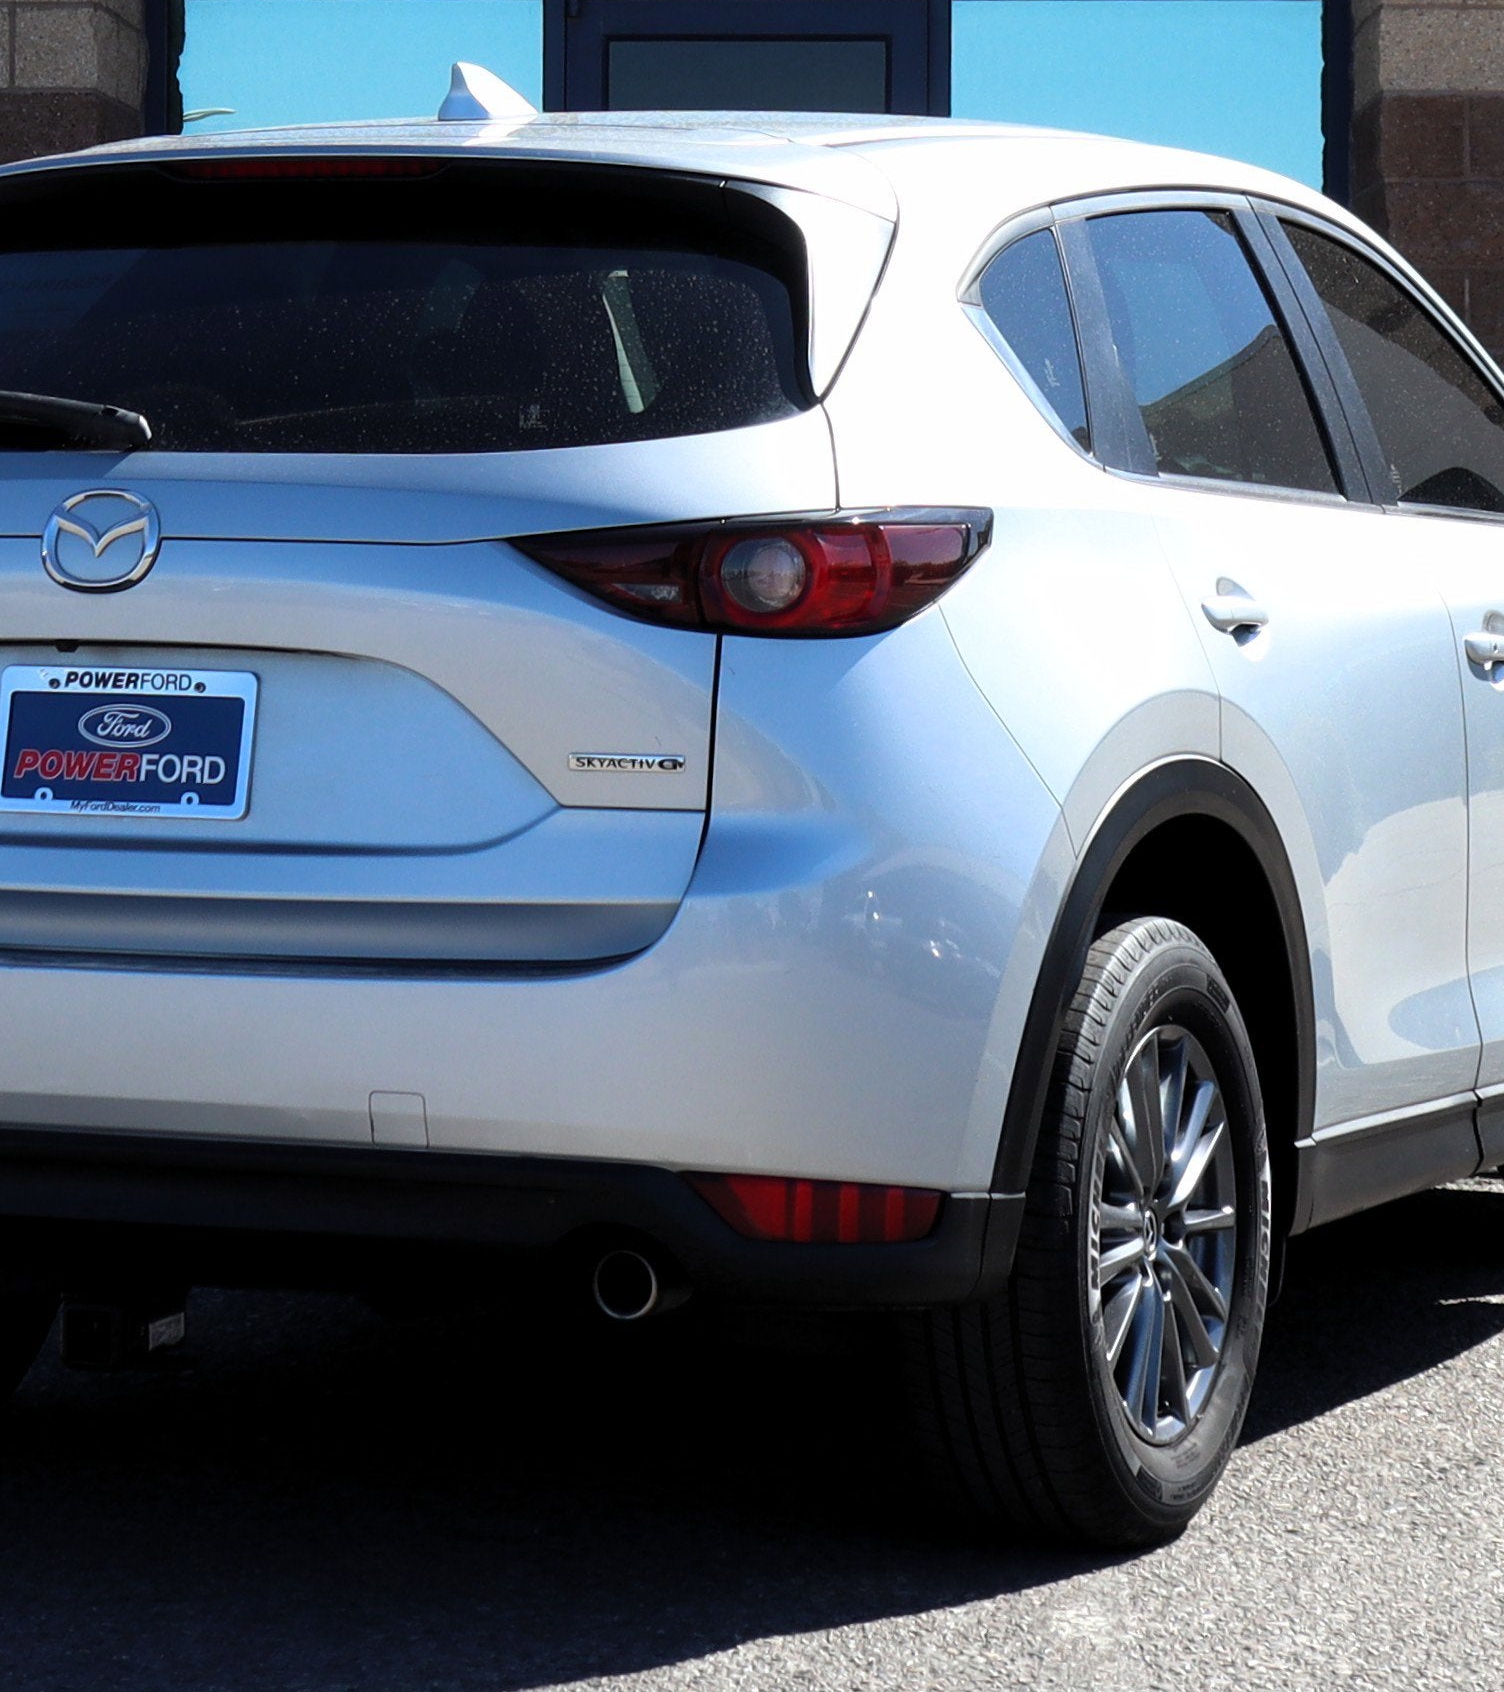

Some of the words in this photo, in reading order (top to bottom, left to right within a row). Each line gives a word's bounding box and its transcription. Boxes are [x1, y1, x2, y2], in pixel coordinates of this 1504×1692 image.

[64, 671, 192, 691] POWERFORD
[97, 711, 152, 739] Ford
[14, 749, 226, 785] POWERFORD
